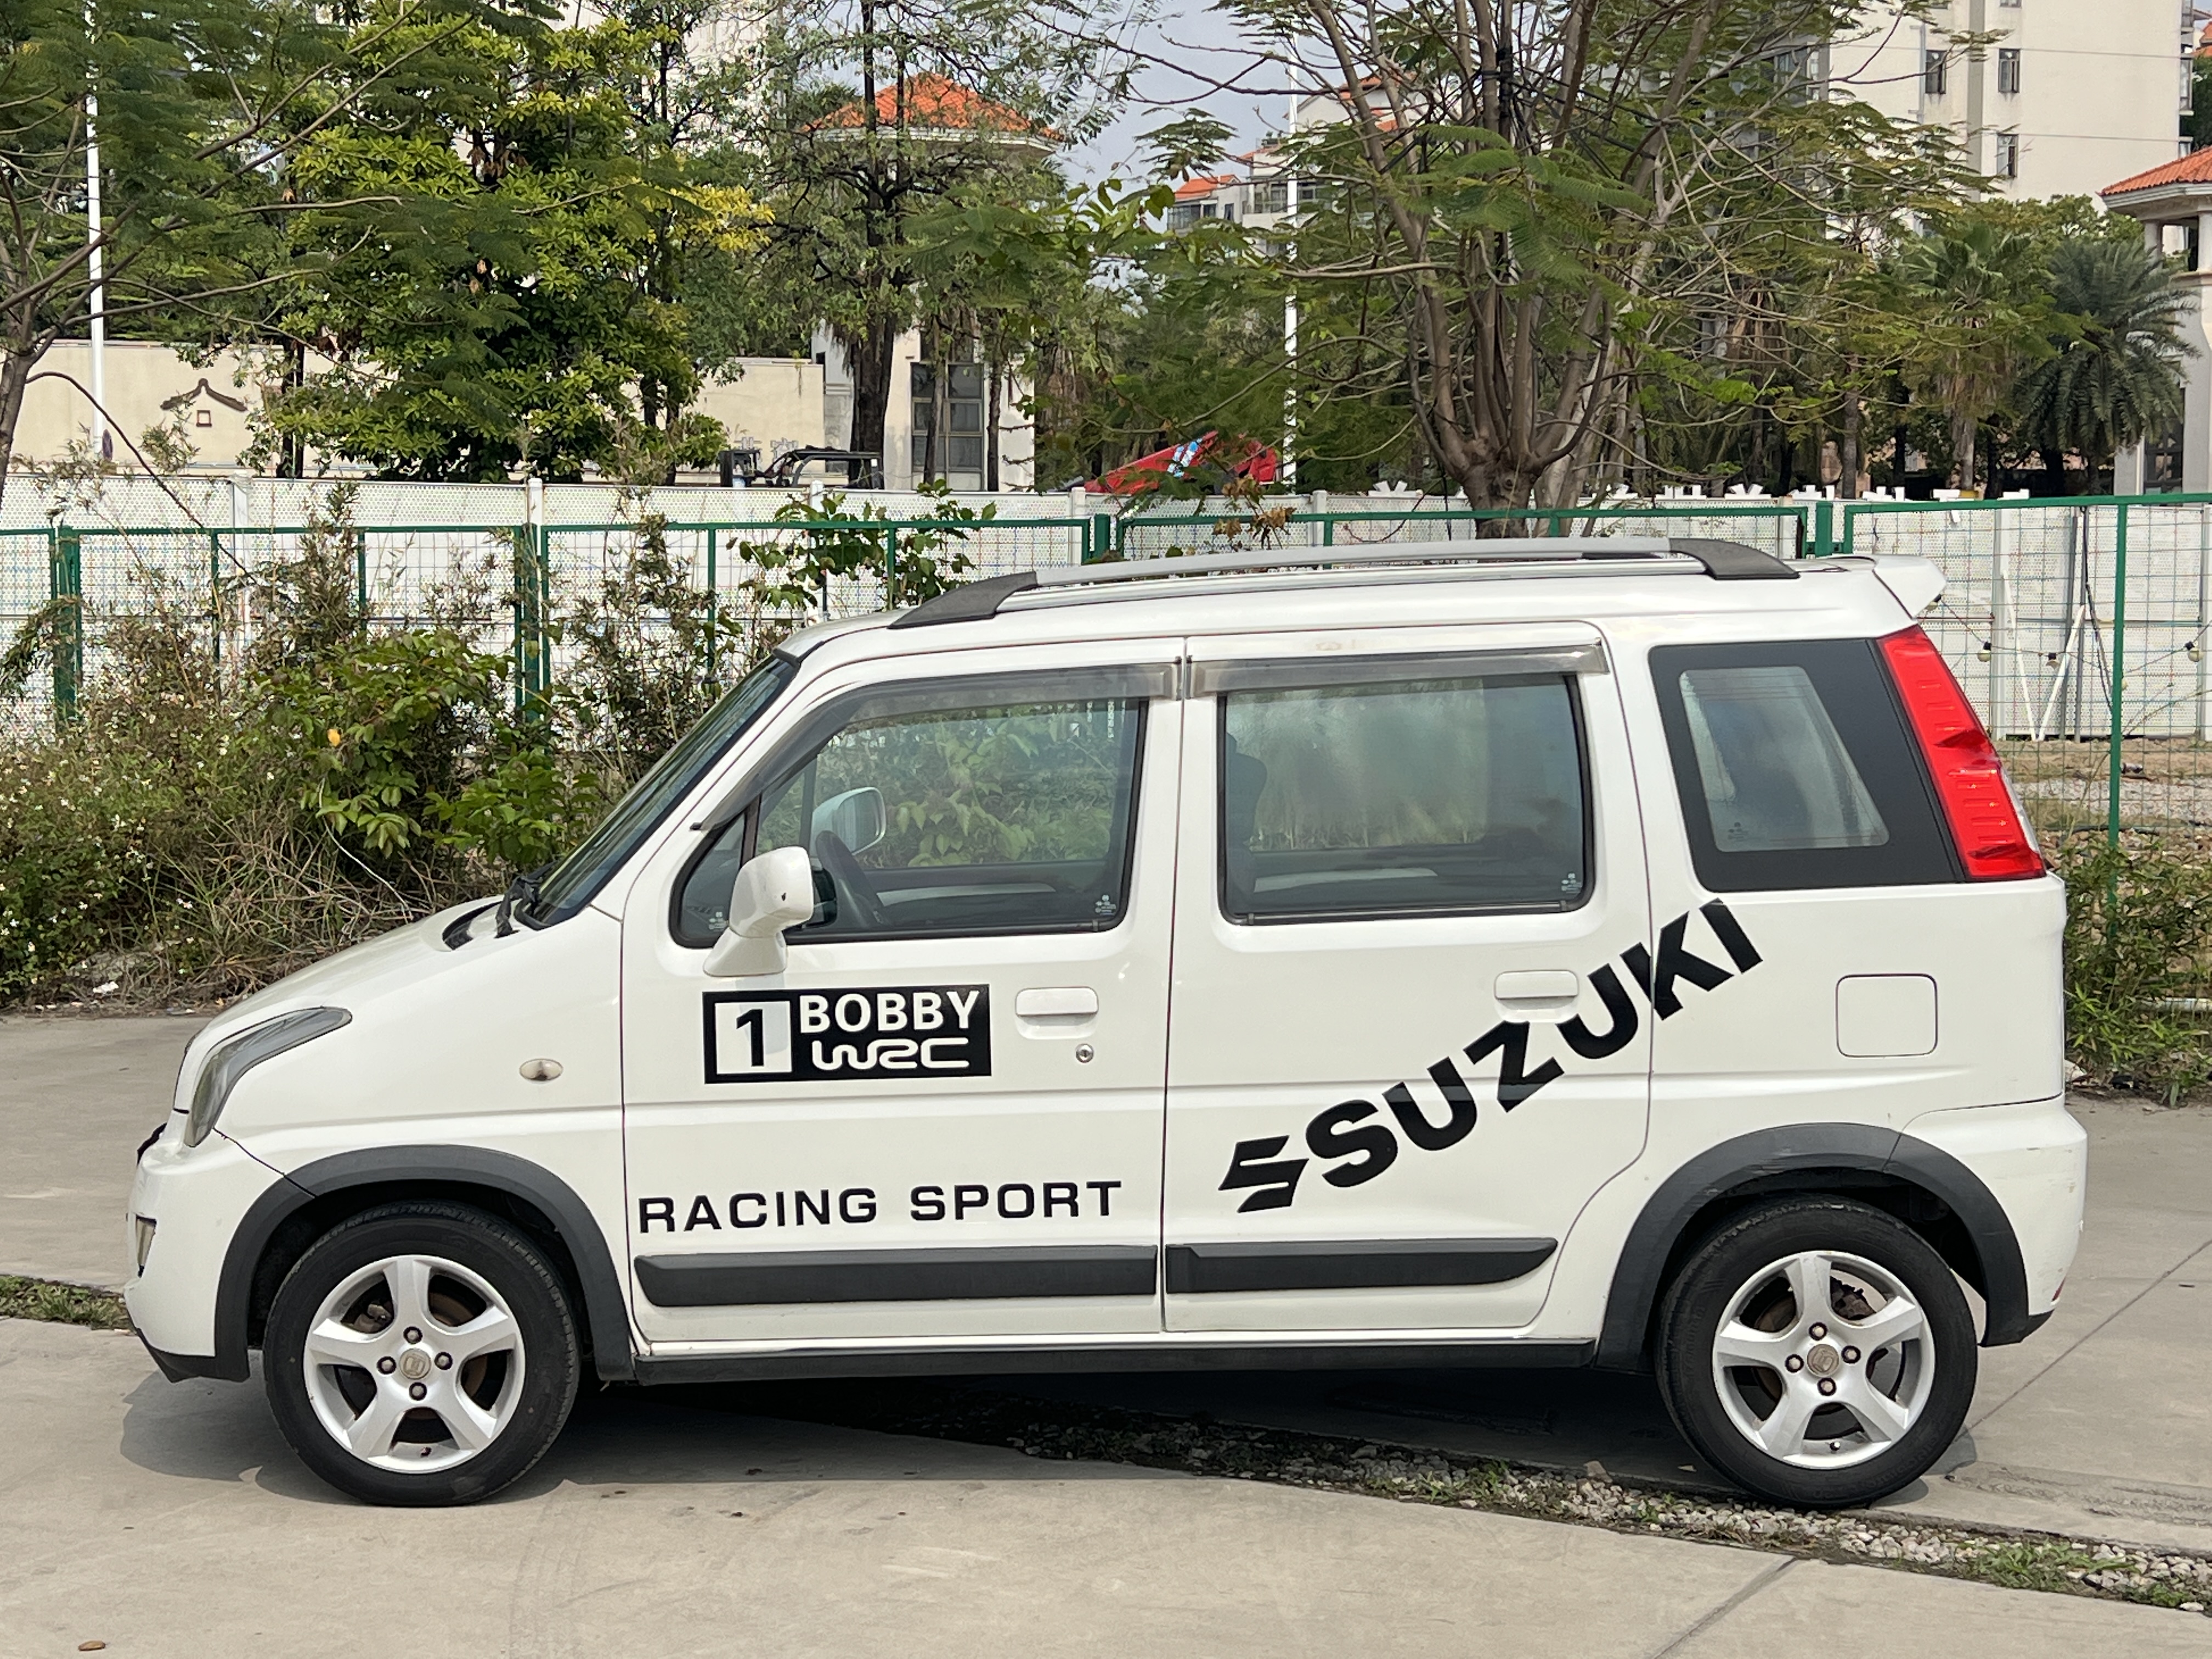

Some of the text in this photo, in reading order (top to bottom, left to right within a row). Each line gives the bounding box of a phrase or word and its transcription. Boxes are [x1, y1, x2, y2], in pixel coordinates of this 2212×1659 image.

[736, 1008, 765, 1068] 1
[799, 990, 980, 1034] BOBBY
[811, 1037, 970, 1071] WRC
[1305, 896, 1764, 1188] SUZUKI
[638, 1180, 1122, 1234] RACING SPORT
